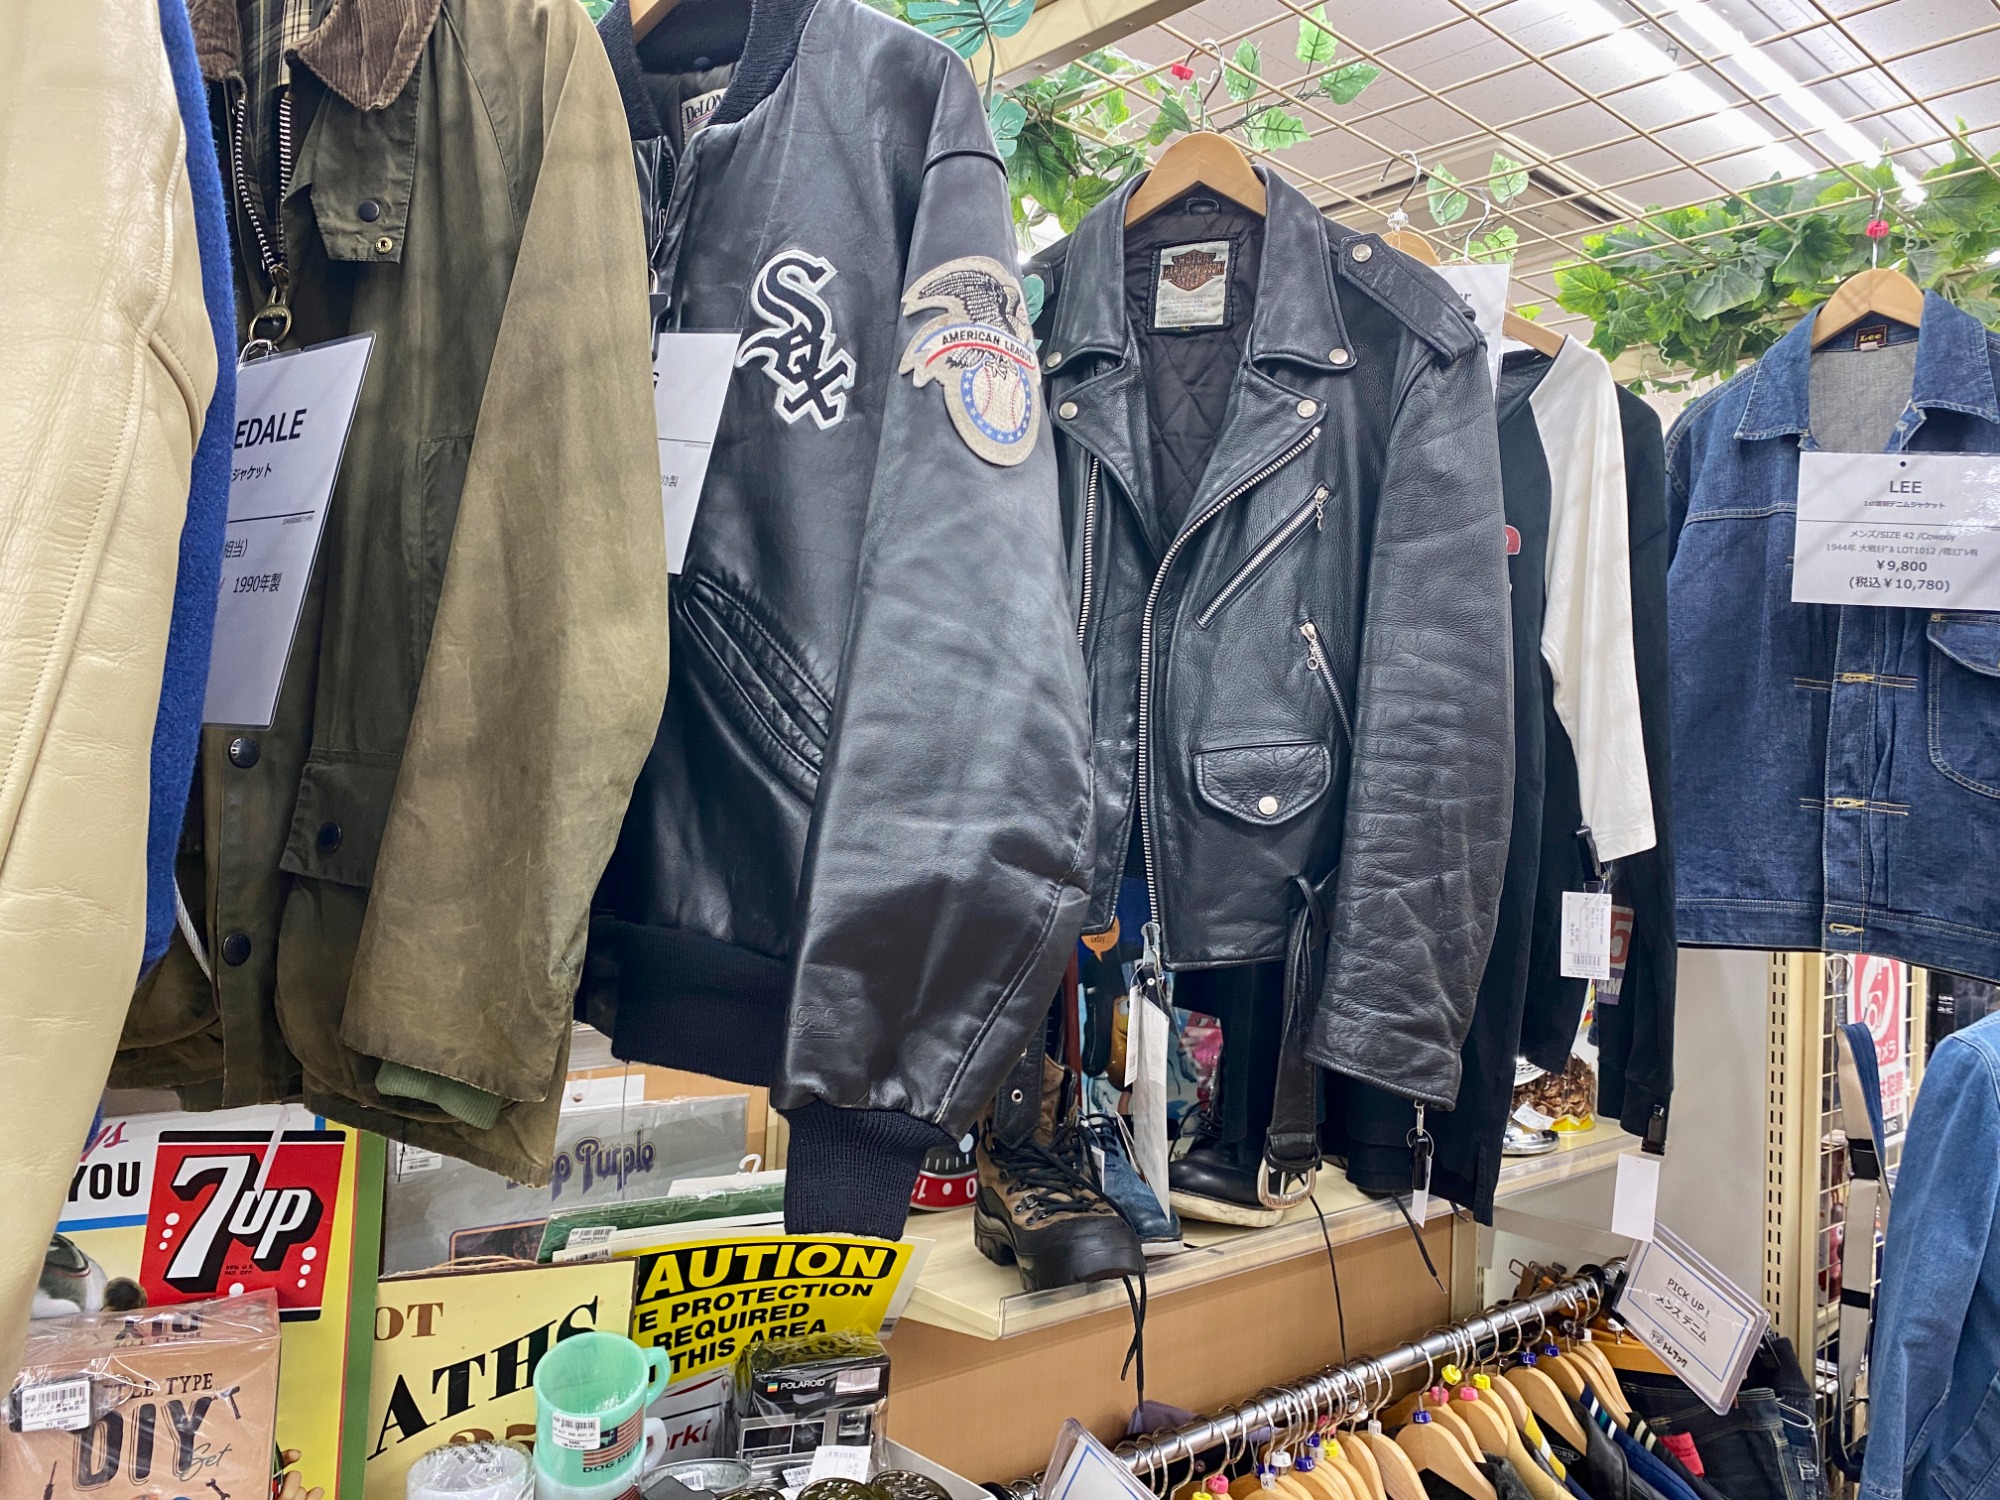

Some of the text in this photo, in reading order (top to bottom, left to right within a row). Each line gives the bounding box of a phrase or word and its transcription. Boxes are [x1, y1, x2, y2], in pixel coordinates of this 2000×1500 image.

[942, 330, 1000, 346] AMERICAN
[1860, 333, 1882, 343] Lee
[233, 409, 307, 450] EDALE
[1889, 480, 1923, 494] LEE
[1826, 543, 1857, 552] 1944年
[1897, 546, 1937, 555] LOT1012
[1849, 530, 1900, 540] メンズ/SIZE
[1902, 532, 1915, 540] 42
[1876, 560, 1928, 573] ¥9,800
[232, 572, 283, 593] 1990年製
[1849, 576, 1951, 593] (税込¥10,780)
[571, 1124, 657, 1196] Purple
[67, 1161, 142, 1203] YOU
[640, 1244, 889, 1301] AUTION
[634, 1283, 874, 1334] E PROTECTION
[1667, 1277, 1691, 1302] PICK
[1691, 1297, 1705, 1312] UP
[373, 1301, 444, 1342] OT
[653, 1302, 810, 1352] REQUIRED
[1682, 1314, 1707, 1343] デニム
[669, 1319, 827, 1375] THIS AREA
[1661, 1341, 1688, 1368] トレファク
[165, 1372, 213, 1396] TYPE
[780, 1379, 826, 1393] POLAROID
[73, 1395, 216, 1492] DIY
[658, 1419, 712, 1452] rki
[178, 1443, 232, 1481] Set
[582, 1462, 615, 1473] DOG
